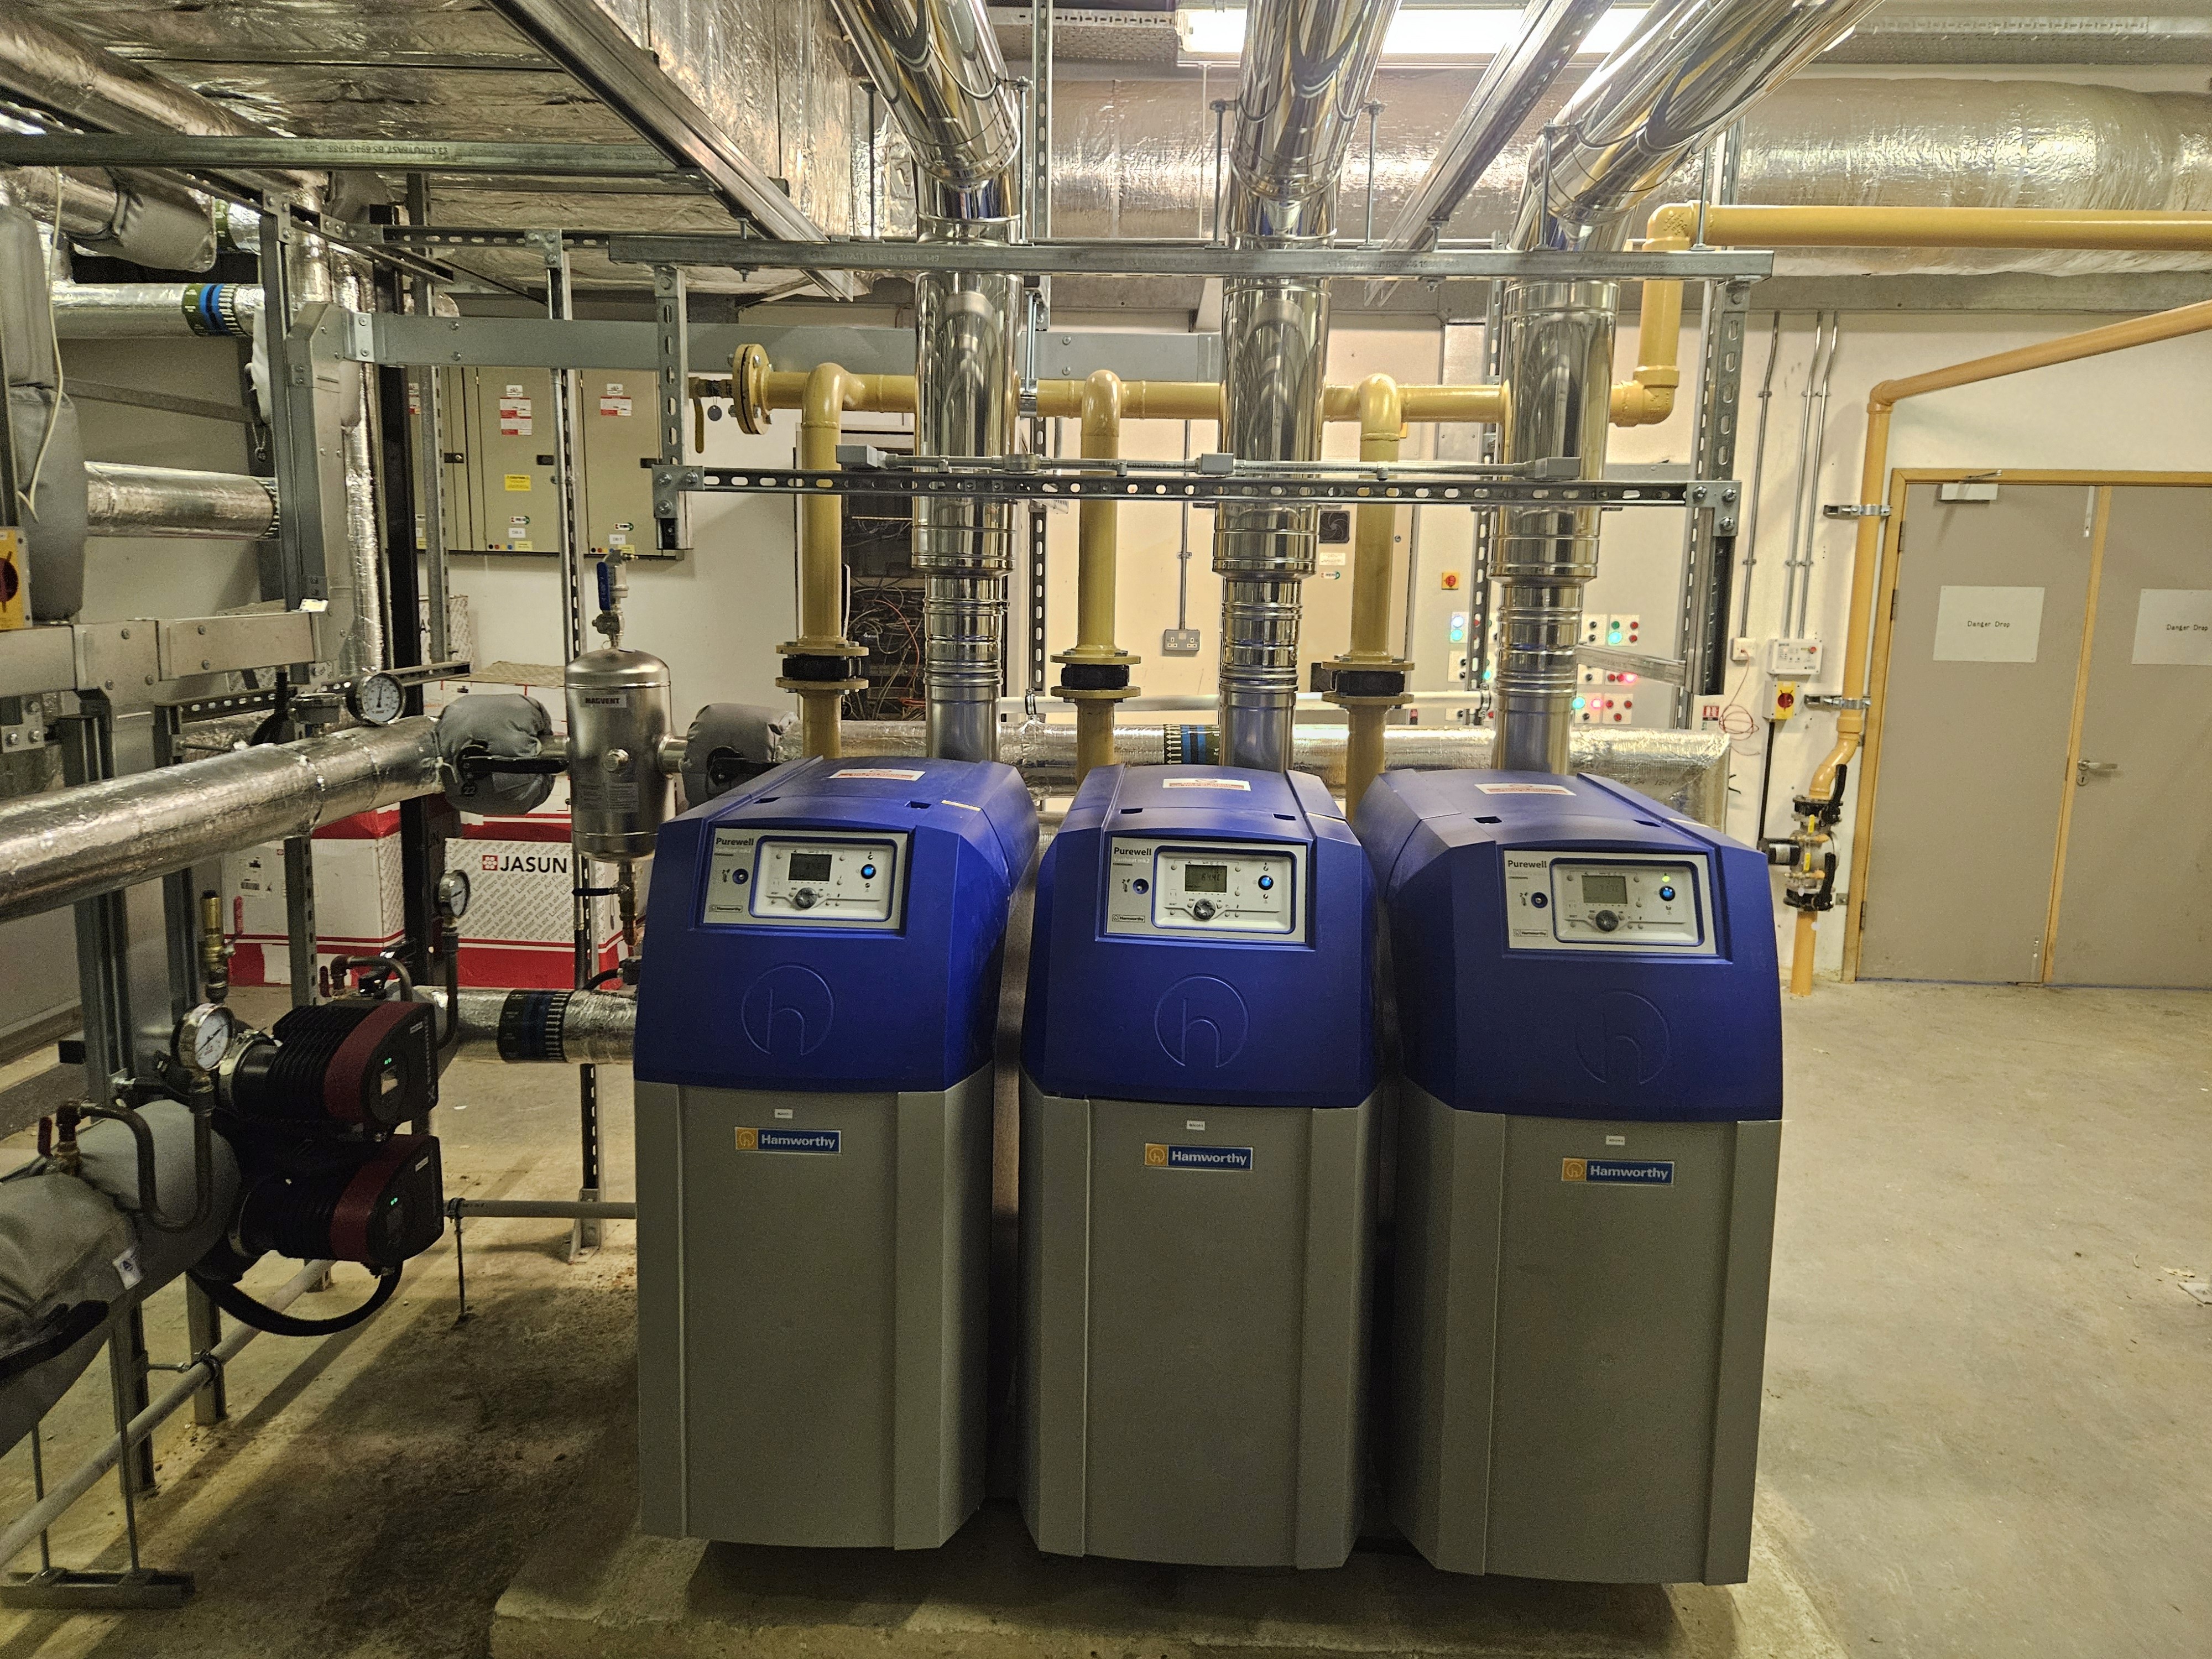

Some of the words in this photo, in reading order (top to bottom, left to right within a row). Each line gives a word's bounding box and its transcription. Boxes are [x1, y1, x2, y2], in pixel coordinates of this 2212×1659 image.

[716, 837, 754, 846] Purewell
[1114, 847, 1151, 855] Purewell
[499, 855, 567, 873] JASUN
[1507, 860, 1547, 868] Purewell
[761, 1134, 836, 1149] Hamworthy
[1172, 1150, 1247, 1166] Hamworthy
[1590, 1165, 1668, 1181] Hamworthy
